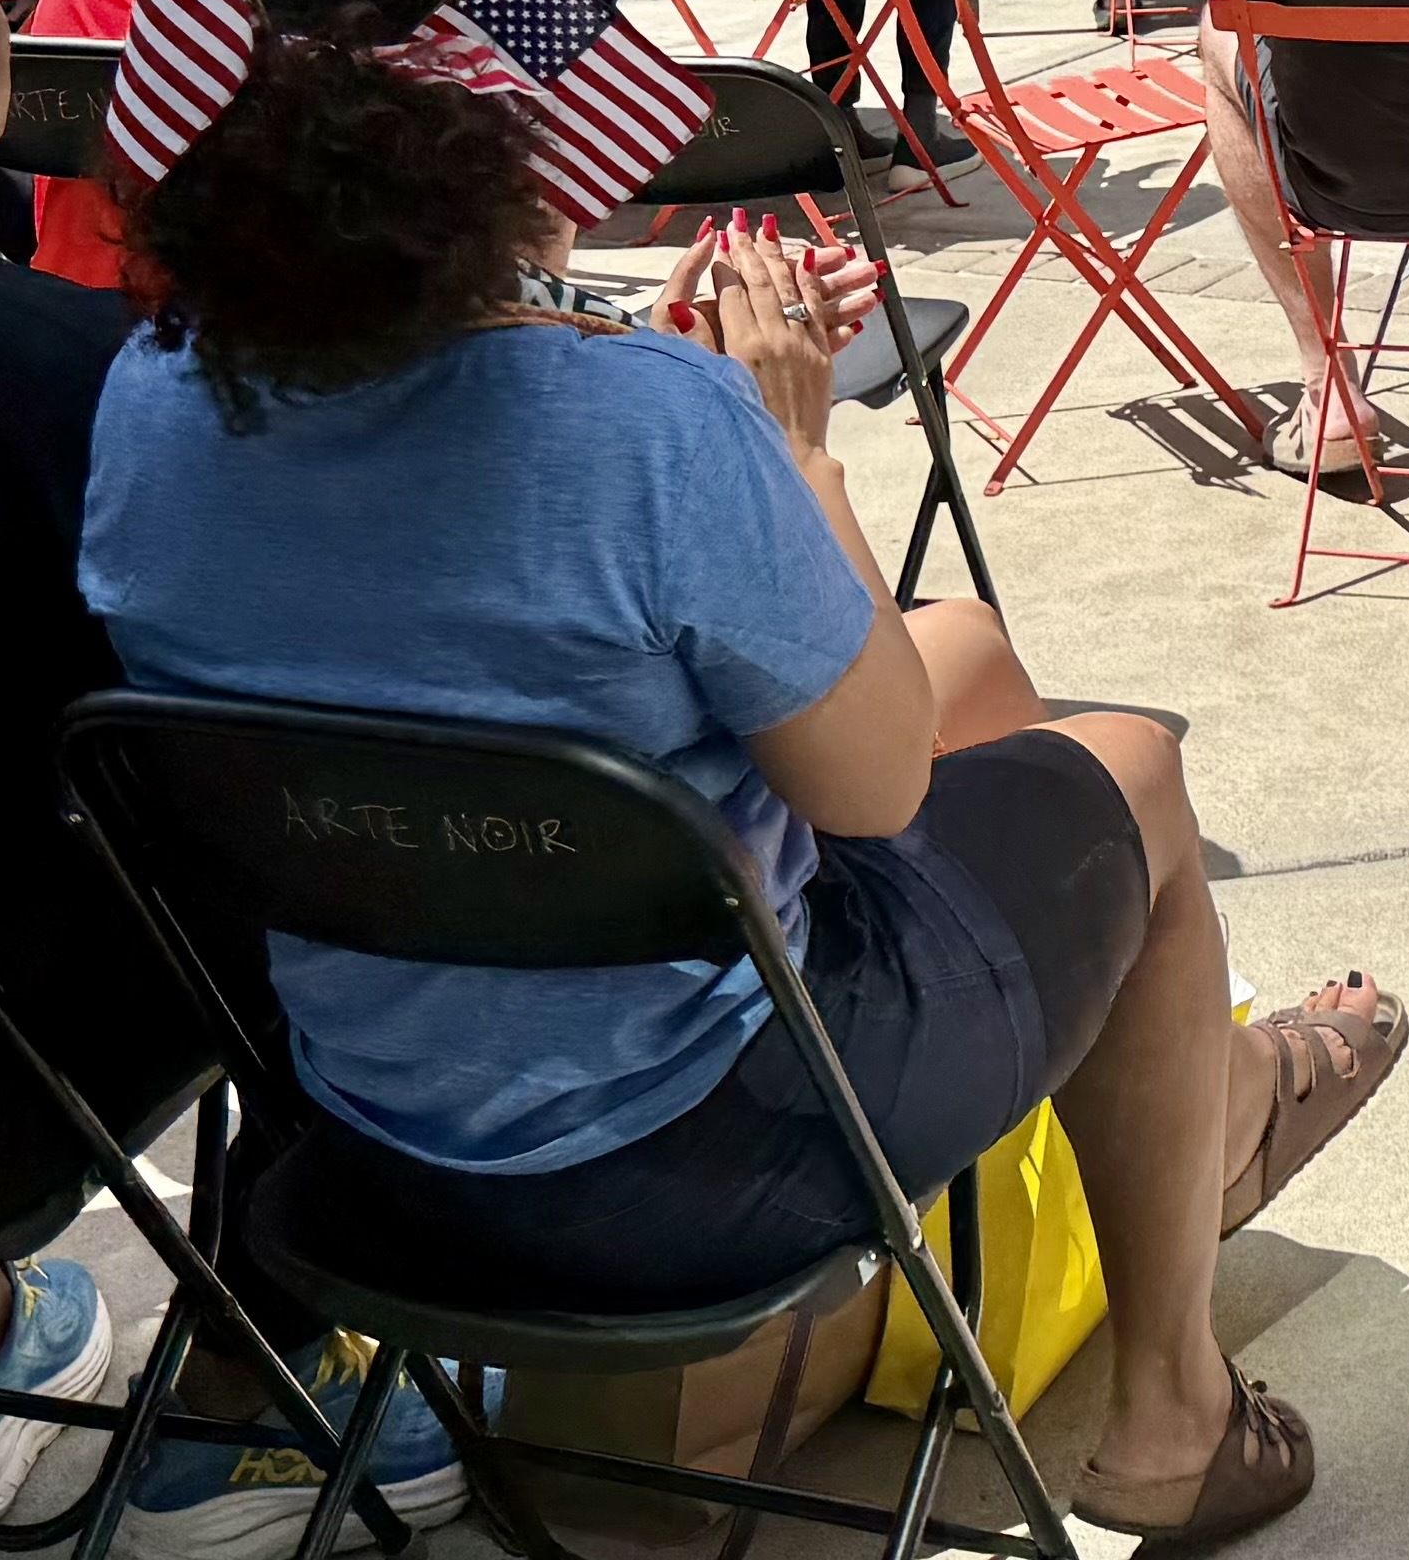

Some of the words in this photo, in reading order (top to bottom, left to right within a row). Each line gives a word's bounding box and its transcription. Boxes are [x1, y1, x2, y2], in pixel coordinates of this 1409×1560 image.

[11, 87, 80, 122] RTE
[281, 786, 420, 848] ARTE
[442, 812, 578, 855] NOIR
